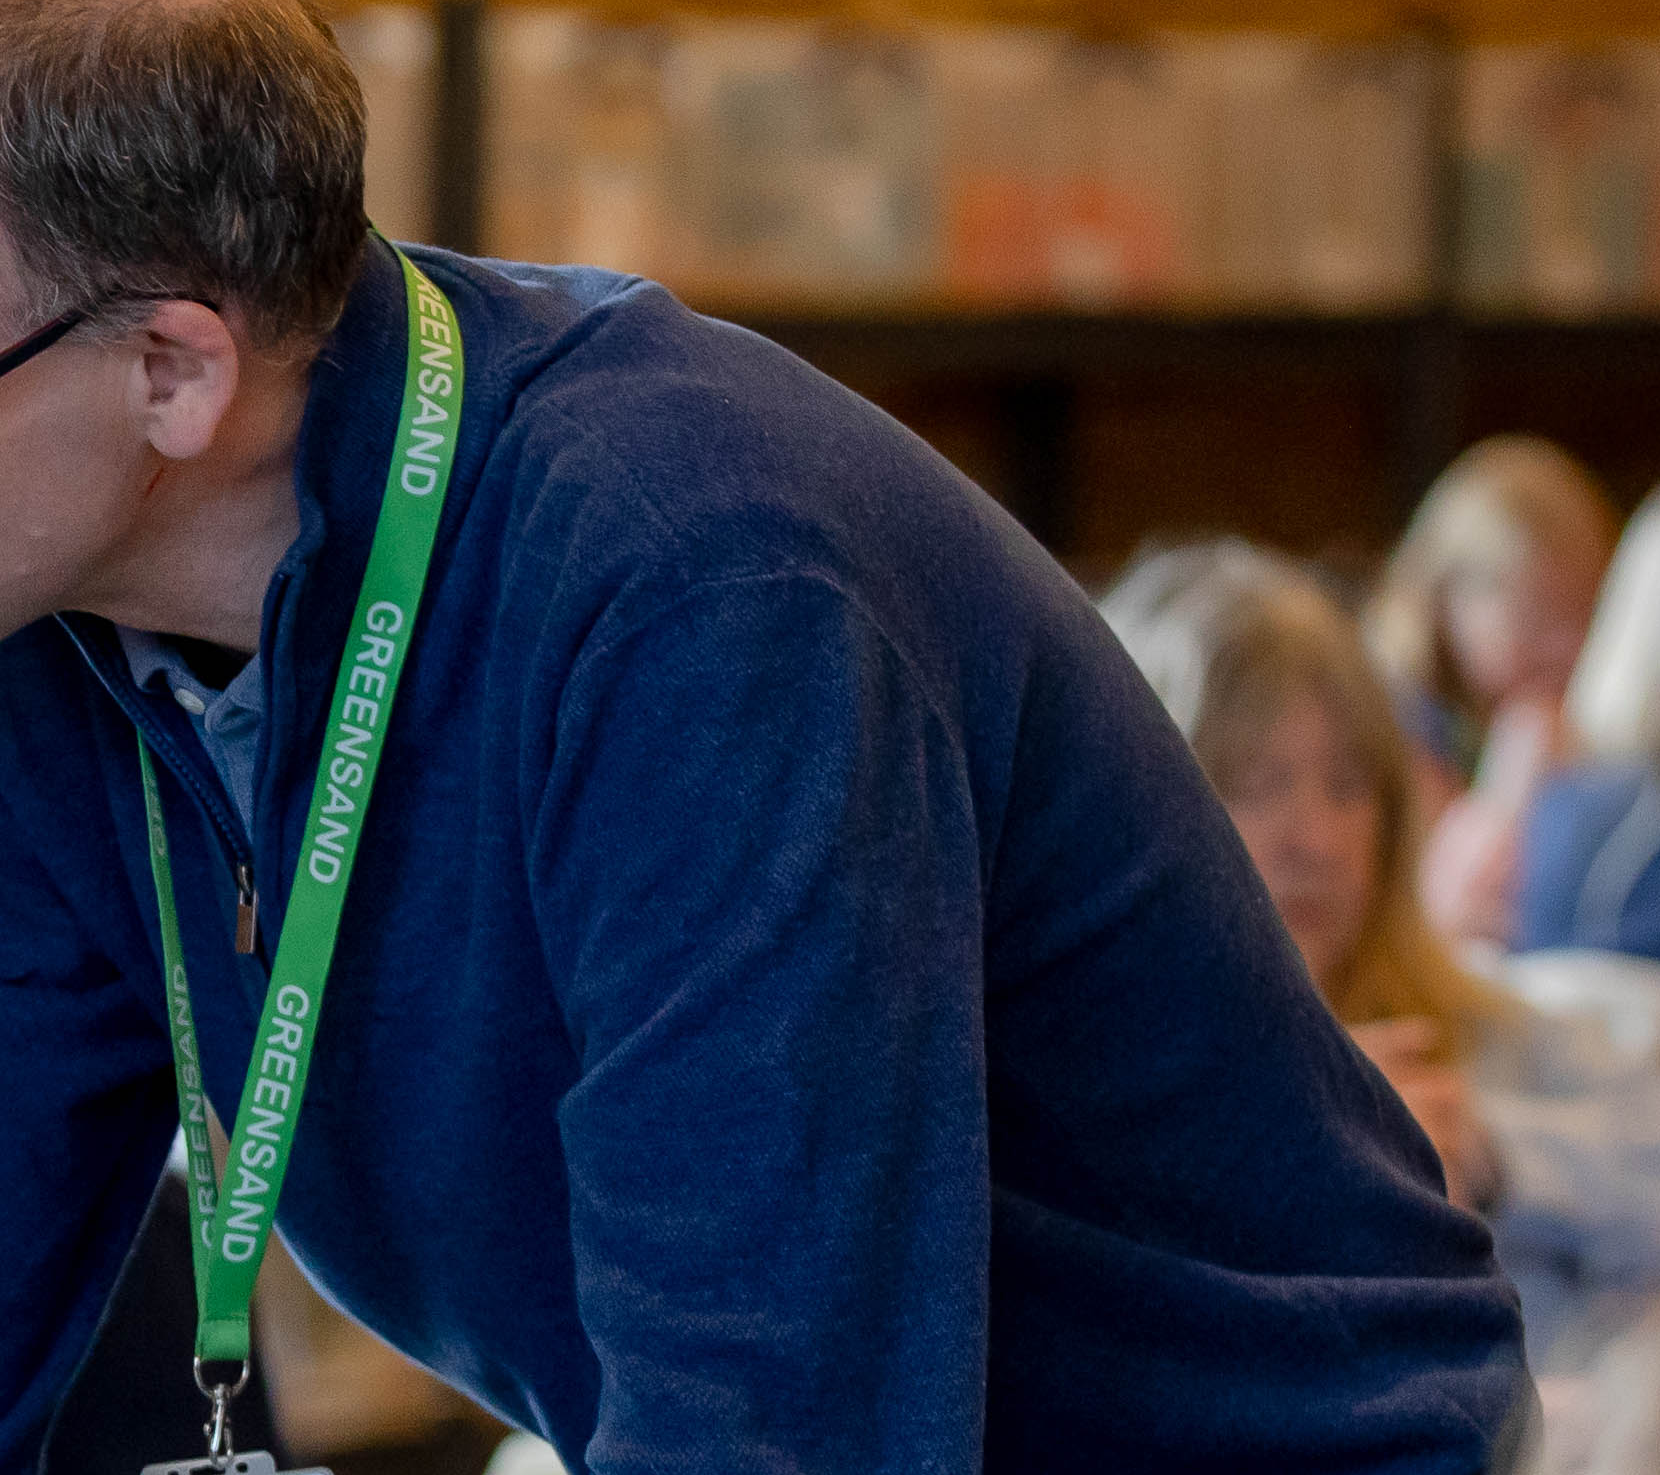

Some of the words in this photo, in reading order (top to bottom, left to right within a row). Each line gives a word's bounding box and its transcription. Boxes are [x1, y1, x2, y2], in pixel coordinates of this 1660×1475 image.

[401, 259, 453, 496] REENSAND
[308, 601, 404, 884] GREENSAND
[222, 984, 310, 1263] GREENSAND
